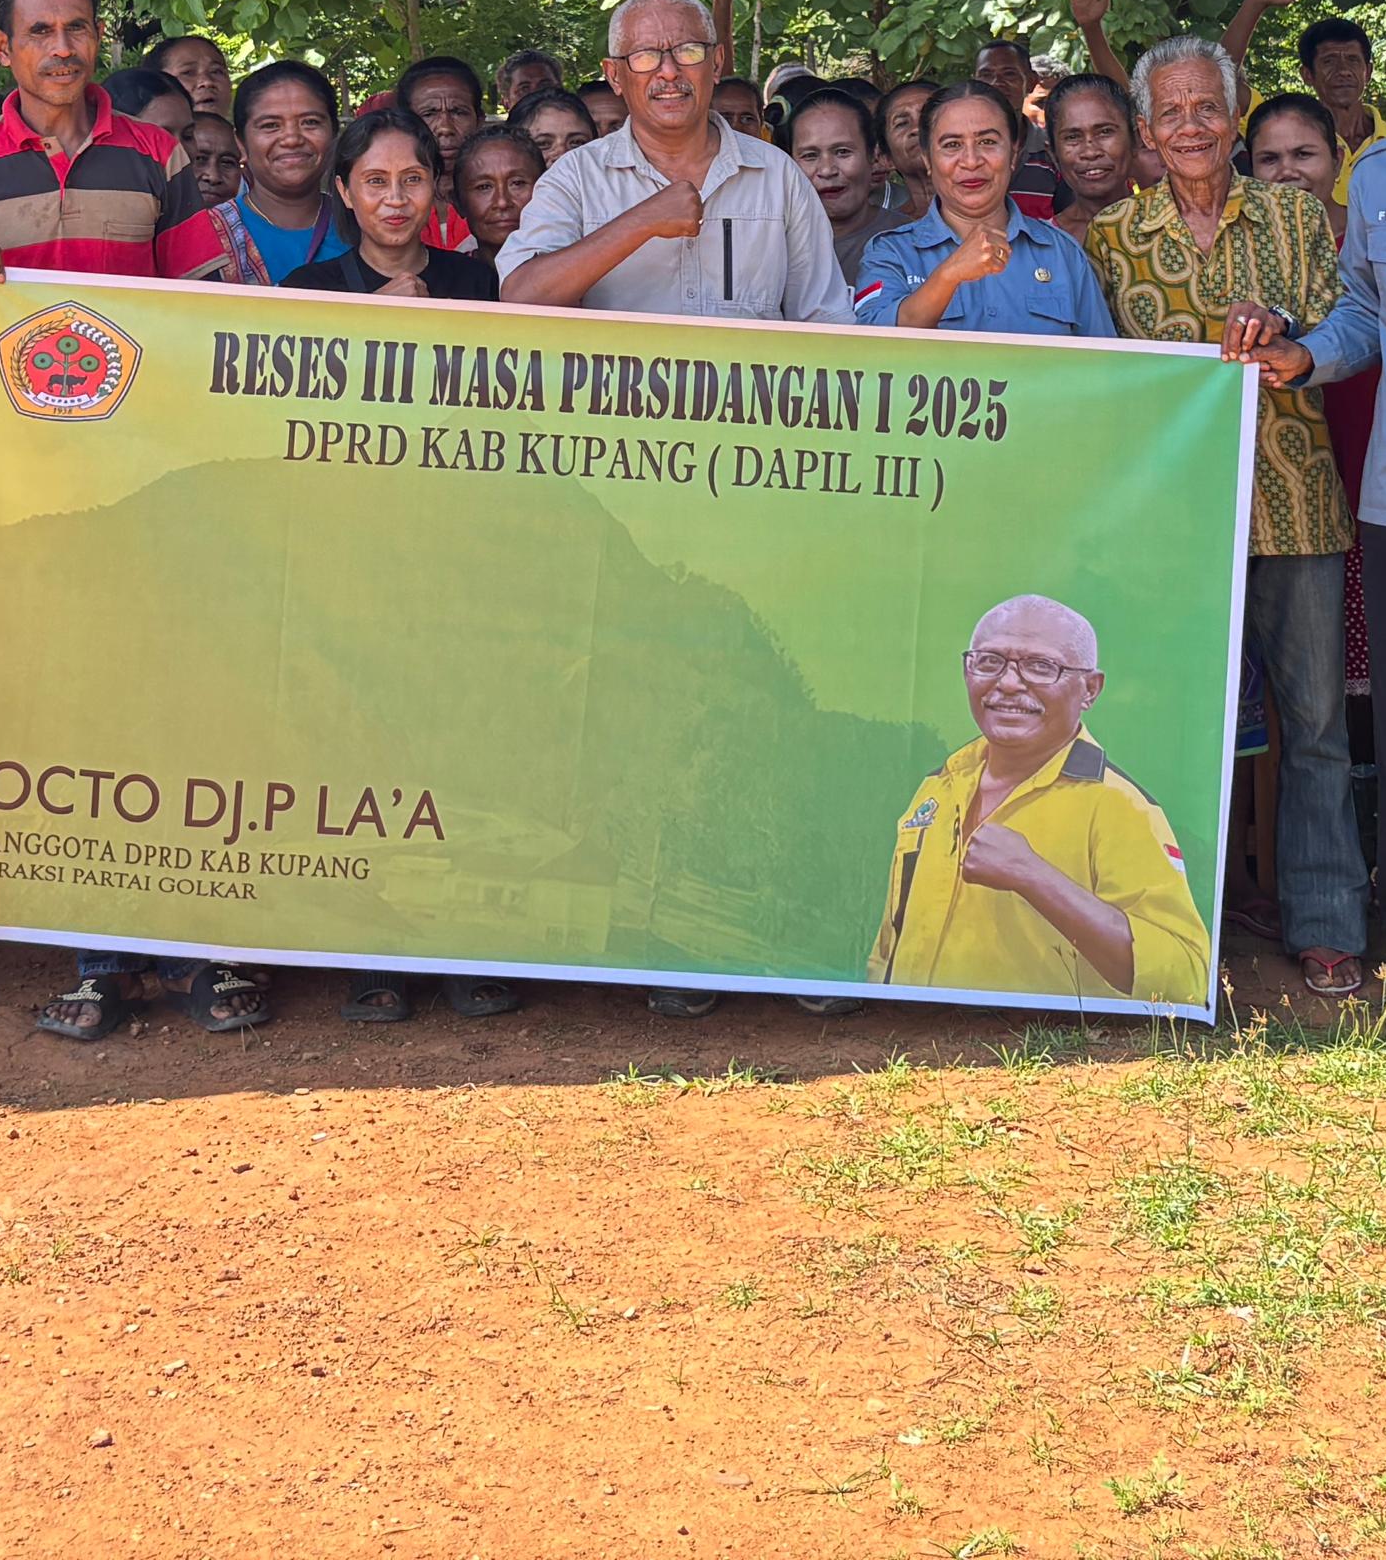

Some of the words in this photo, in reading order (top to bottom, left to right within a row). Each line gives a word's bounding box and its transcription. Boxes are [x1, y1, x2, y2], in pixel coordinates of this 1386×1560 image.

[209, 331, 350, 402] RESES
[360, 340, 419, 405] III
[428, 343, 545, 413] MASA
[557, 351, 864, 433] PERSIDANGAN
[874, 371, 894, 434] I
[904, 374, 1009, 443] 2025
[283, 419, 407, 466] DPRD
[417, 425, 505, 473] KAB
[516, 431, 697, 484] KUPANG
[730, 444, 862, 494] DAPIL
[184, 778, 296, 847] DJ.P
[316, 785, 446, 841] LA'A
[72, 866, 152, 891] PARTAI
[158, 876, 258, 900] GOLKAR
[124, 842, 193, 870] DPRD
[199, 848, 251, 875] KAB
[259, 852, 371, 881] KUPANG
